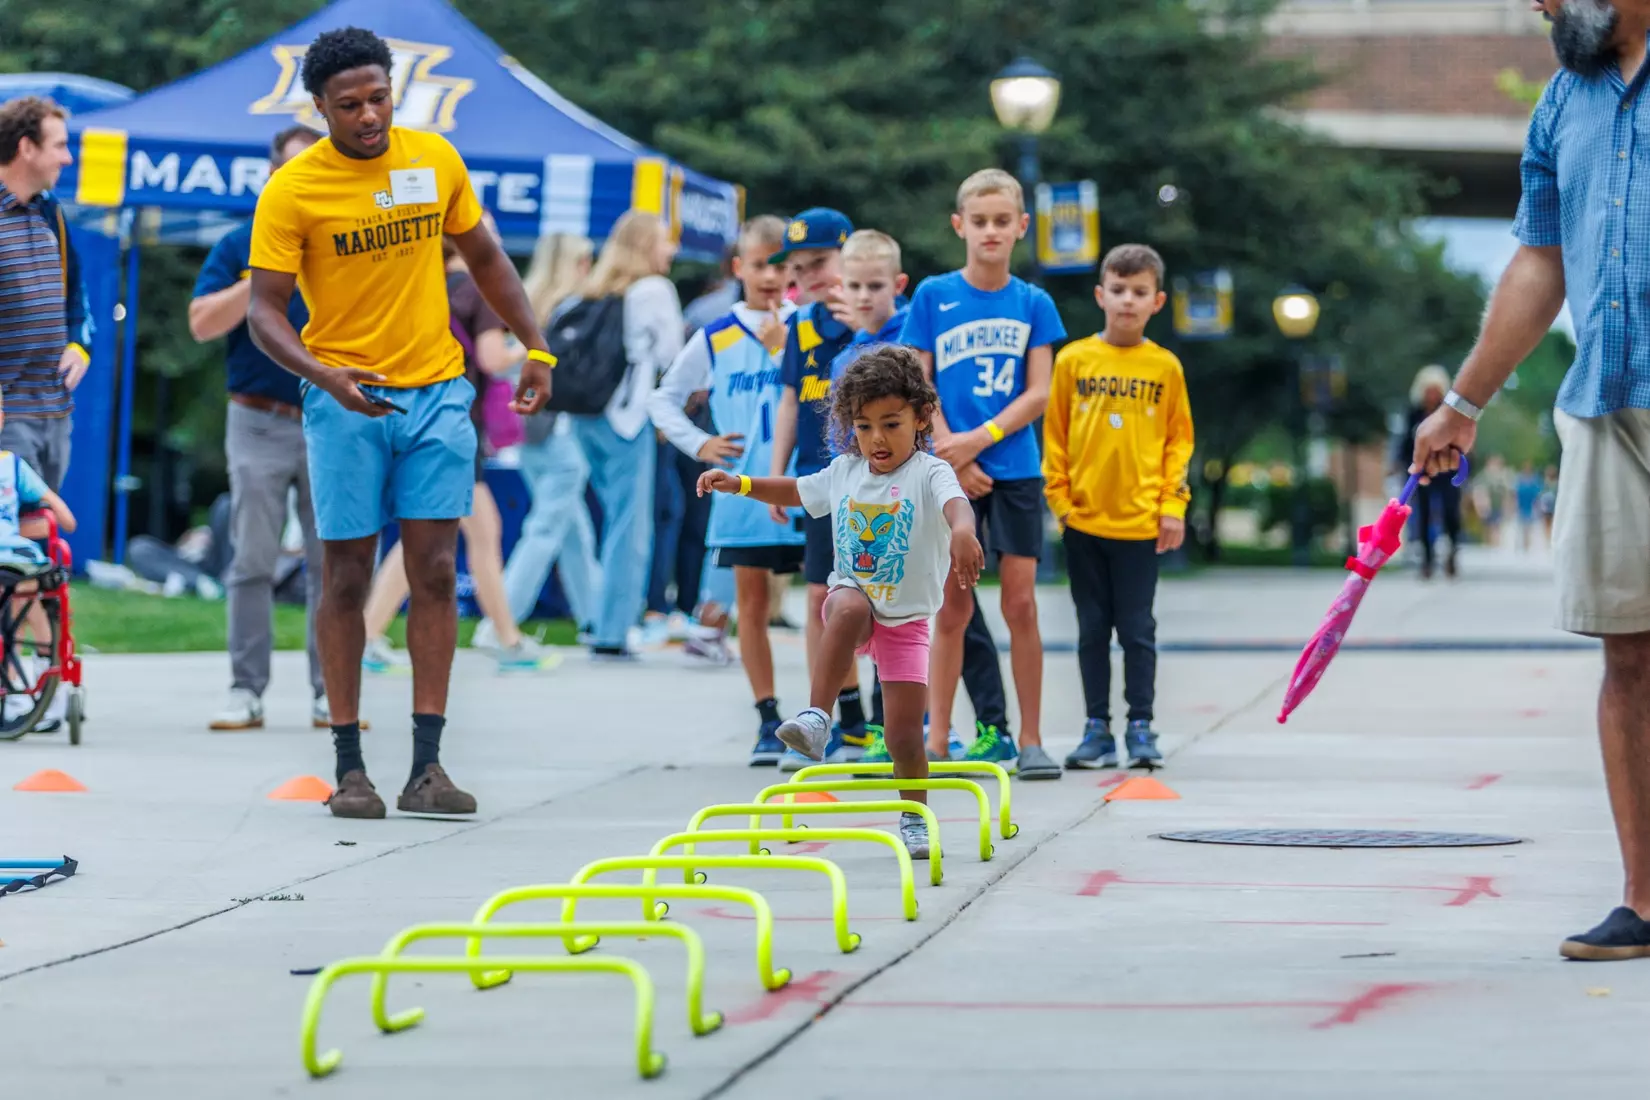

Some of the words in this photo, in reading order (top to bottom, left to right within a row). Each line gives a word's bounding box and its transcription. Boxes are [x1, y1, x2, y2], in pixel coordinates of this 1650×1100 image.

[943, 325, 1020, 361] MILWAUKEE
[972, 356, 1016, 397] 34
[1076, 376, 1164, 405] MARQUETTE
